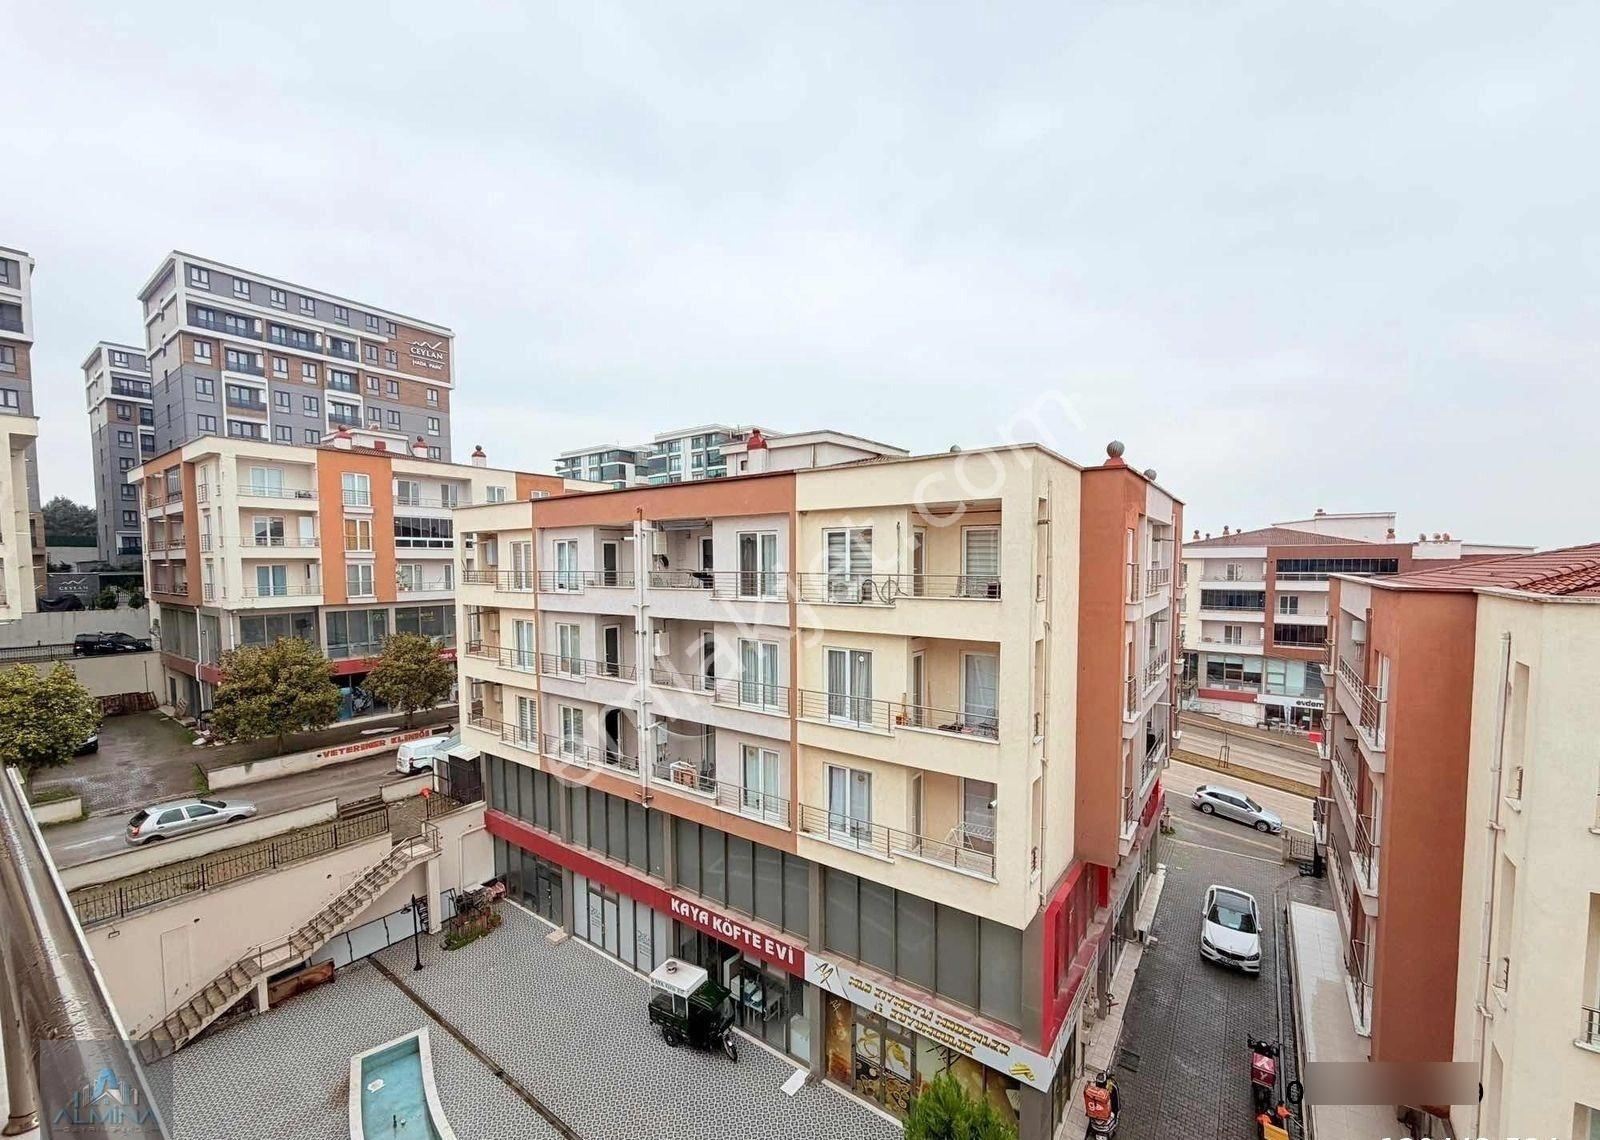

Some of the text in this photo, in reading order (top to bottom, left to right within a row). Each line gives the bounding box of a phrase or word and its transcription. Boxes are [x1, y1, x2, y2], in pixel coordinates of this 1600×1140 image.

[410, 346, 443, 360] CEYLAN
[671, 897, 709, 926] KAYA
[712, 918, 761, 950] KÖFTE
